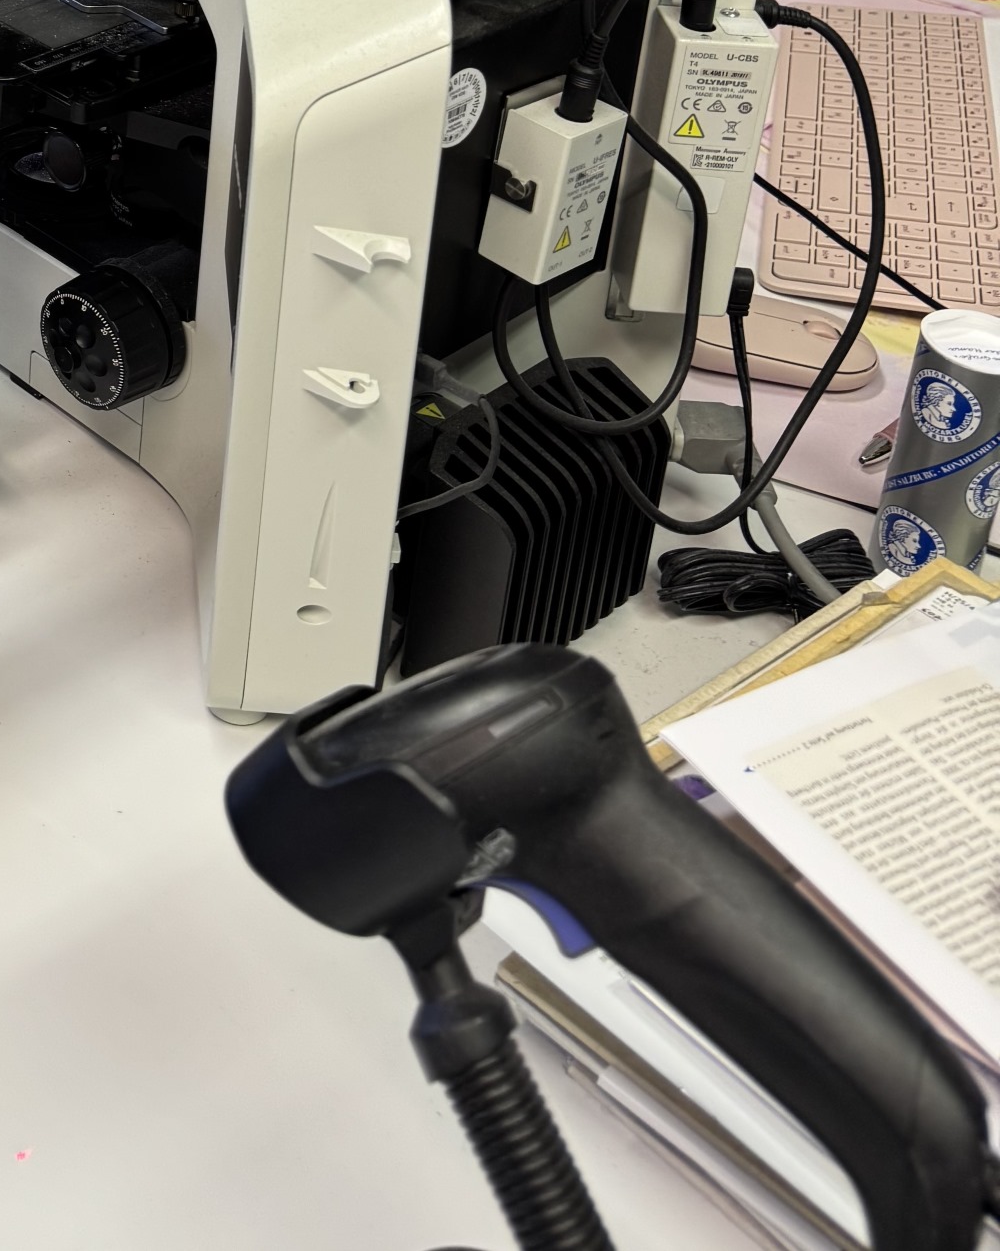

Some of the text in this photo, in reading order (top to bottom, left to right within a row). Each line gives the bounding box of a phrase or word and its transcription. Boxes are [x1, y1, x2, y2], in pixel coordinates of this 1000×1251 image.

[690, 52, 759, 63] MODEL U-CBS
[696, 78, 748, 88] OLYMPUS
[574, 172, 604, 189] OLYMPUS
